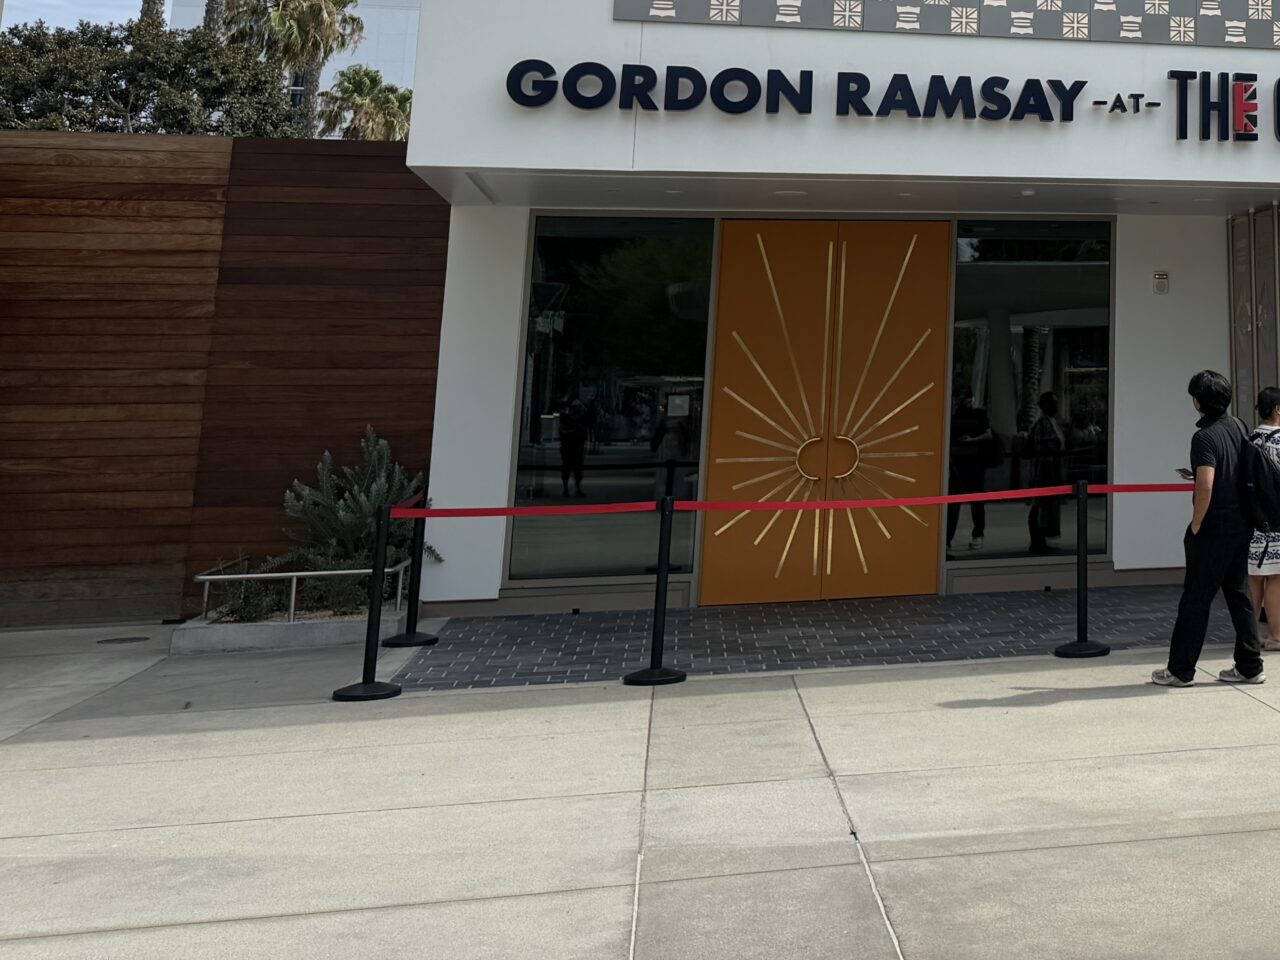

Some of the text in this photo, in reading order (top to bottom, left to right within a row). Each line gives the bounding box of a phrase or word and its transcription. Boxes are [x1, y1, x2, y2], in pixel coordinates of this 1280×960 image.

[506, 59, 814, 114] GORDON
[836, 71, 1089, 122] RAMSAY
[1167, 70, 1259, 142] THE
